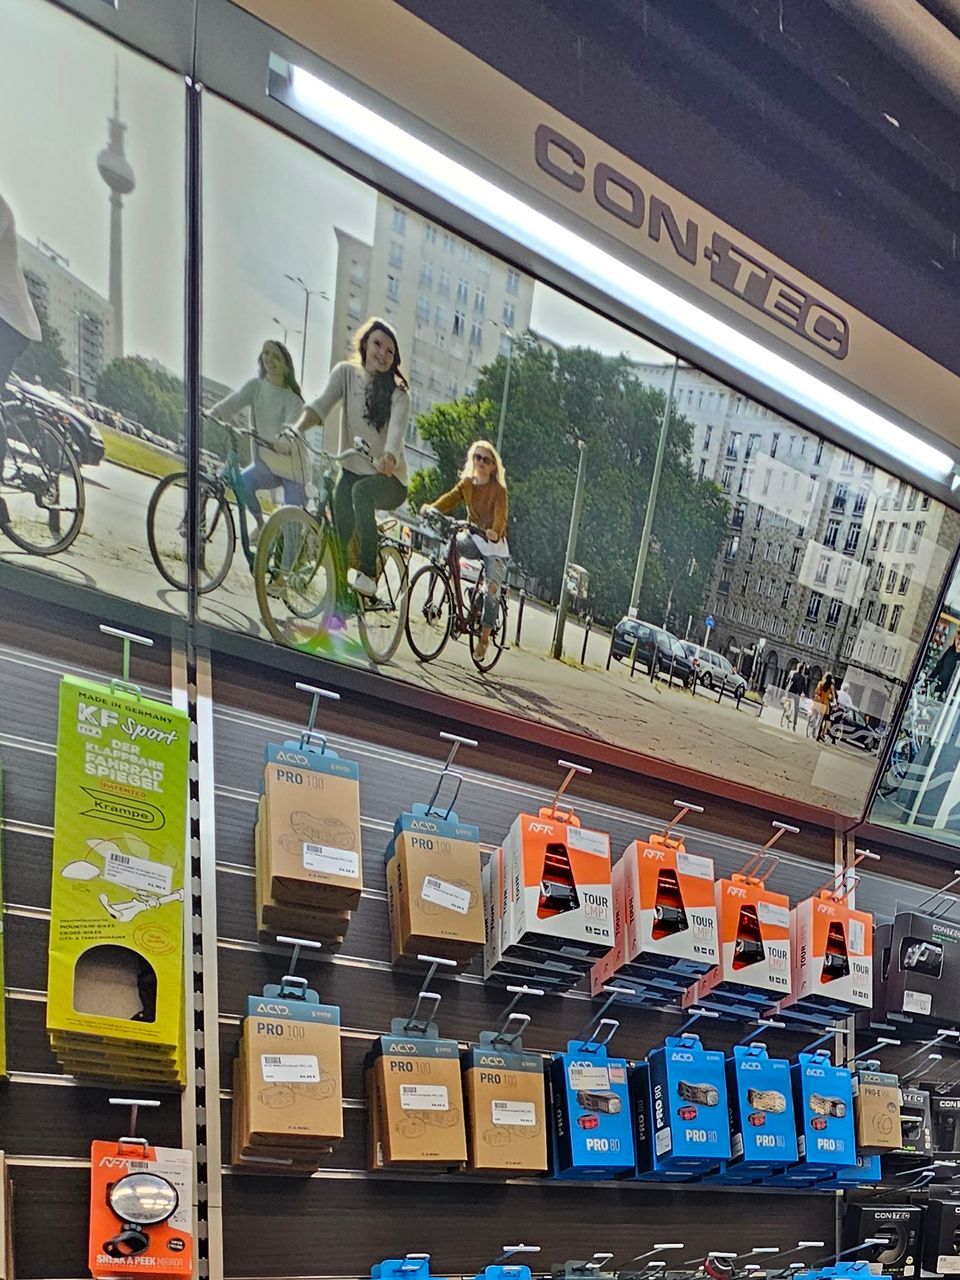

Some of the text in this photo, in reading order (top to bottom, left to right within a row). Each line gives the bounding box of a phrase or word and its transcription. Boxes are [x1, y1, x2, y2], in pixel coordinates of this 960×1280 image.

[78, 691, 173, 724] MADE IN GERMANY
[77, 702, 179, 745] KF Sport
[111, 739, 140, 755] DER
[84, 742, 165, 772] KLAPPBARE
[84, 752, 165, 782] FAHRRAD
[83, 762, 164, 793] SPIEGEL
[276, 769, 303, 785] PRO
[94, 801, 149, 820] Krampe
[411, 837, 434, 850] PRO
[583, 892, 608, 908] TOUR
[691, 914, 713, 929] TOUR
[767, 946, 787, 960] TOUR
[257, 1022, 284, 1036] PRO
[390, 1060, 413, 1073] PRO
[480, 1072, 501, 1084] PRO
[655, 1103, 665, 1129] PRO
[685, 1128, 718, 1143] PRO 80
[755, 1134, 786, 1148] PRO 80
[586, 1138, 621, 1151] PRO 80
[817, 1138, 845, 1152] PRO 80
[96, 1254, 125, 1265] SNEAK
[127, 1256, 134, 1265] A
[135, 1256, 156, 1266] PEEK
